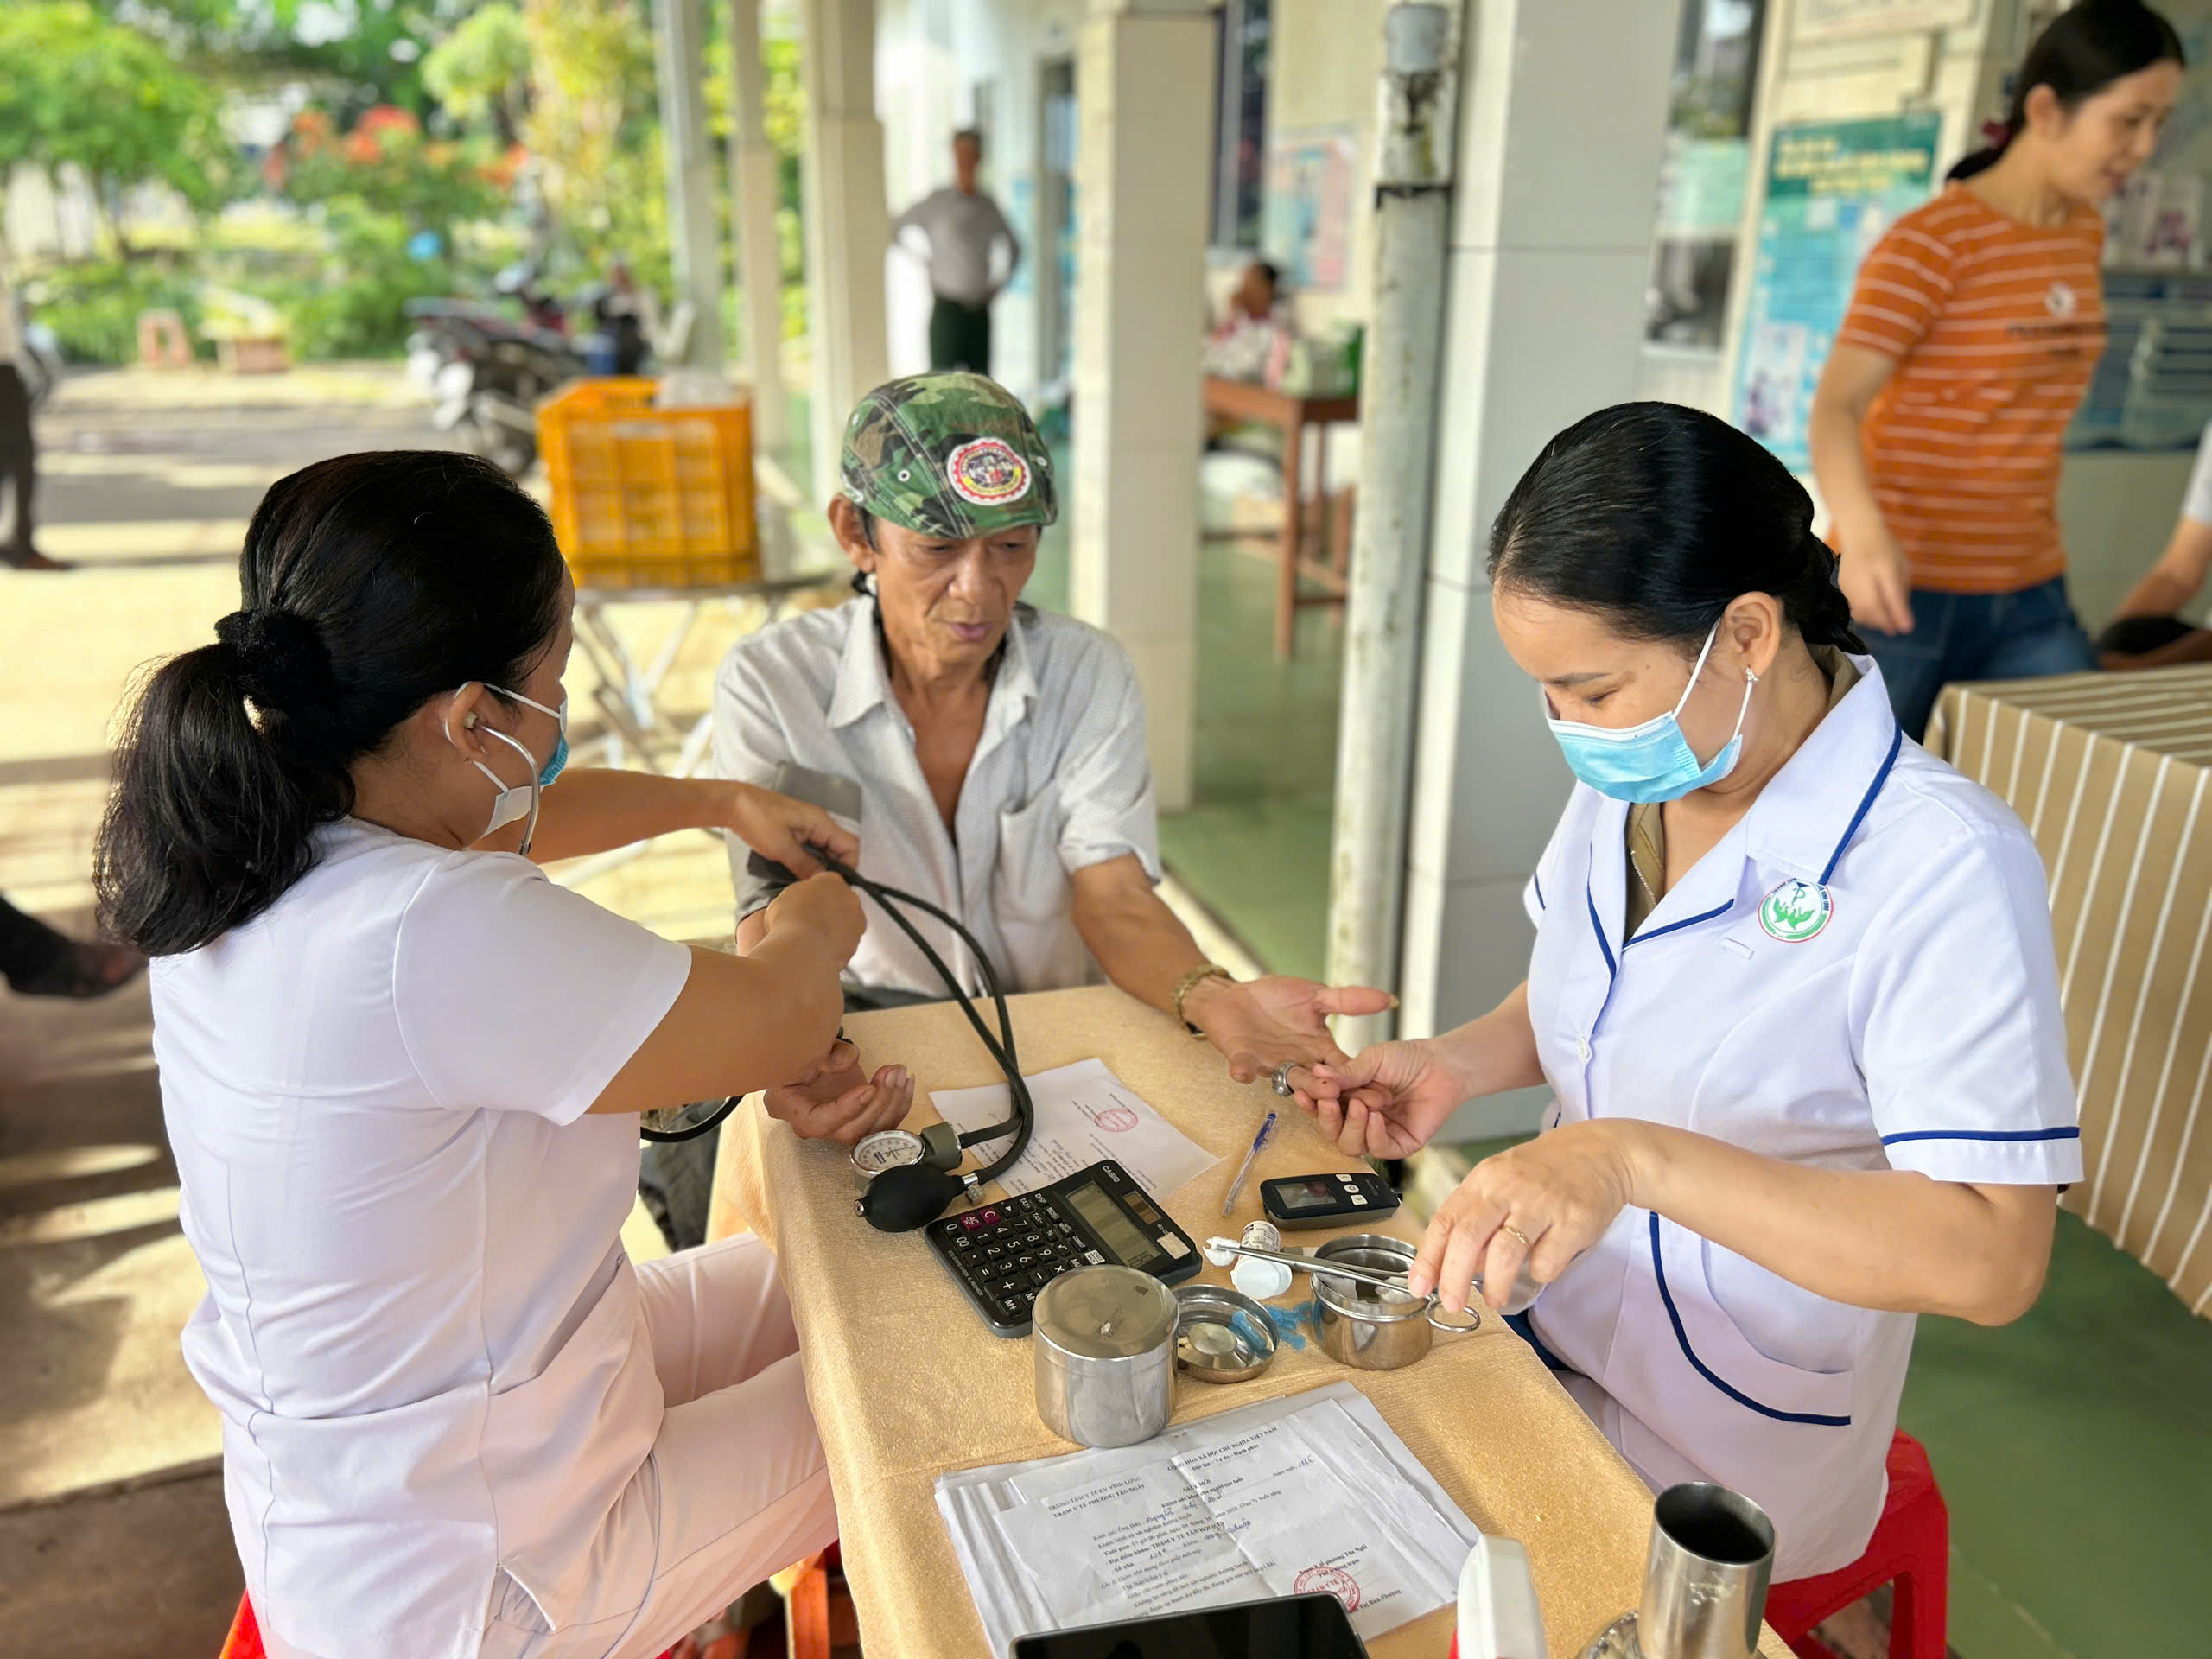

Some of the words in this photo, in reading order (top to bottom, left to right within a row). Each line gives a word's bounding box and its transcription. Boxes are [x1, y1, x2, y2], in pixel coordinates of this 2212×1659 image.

[1102, 1165, 1120, 1183] CASIO
[967, 1216, 979, 1224] AC
[946, 1224, 957, 1232] 0
[956, 1236, 970, 1248] 00
[1007, 1240, 1020, 1249] 5
[987, 1247, 1001, 1255] 2
[1000, 1262, 1013, 1270] 3
[1005, 1299, 1018, 1310] M+
